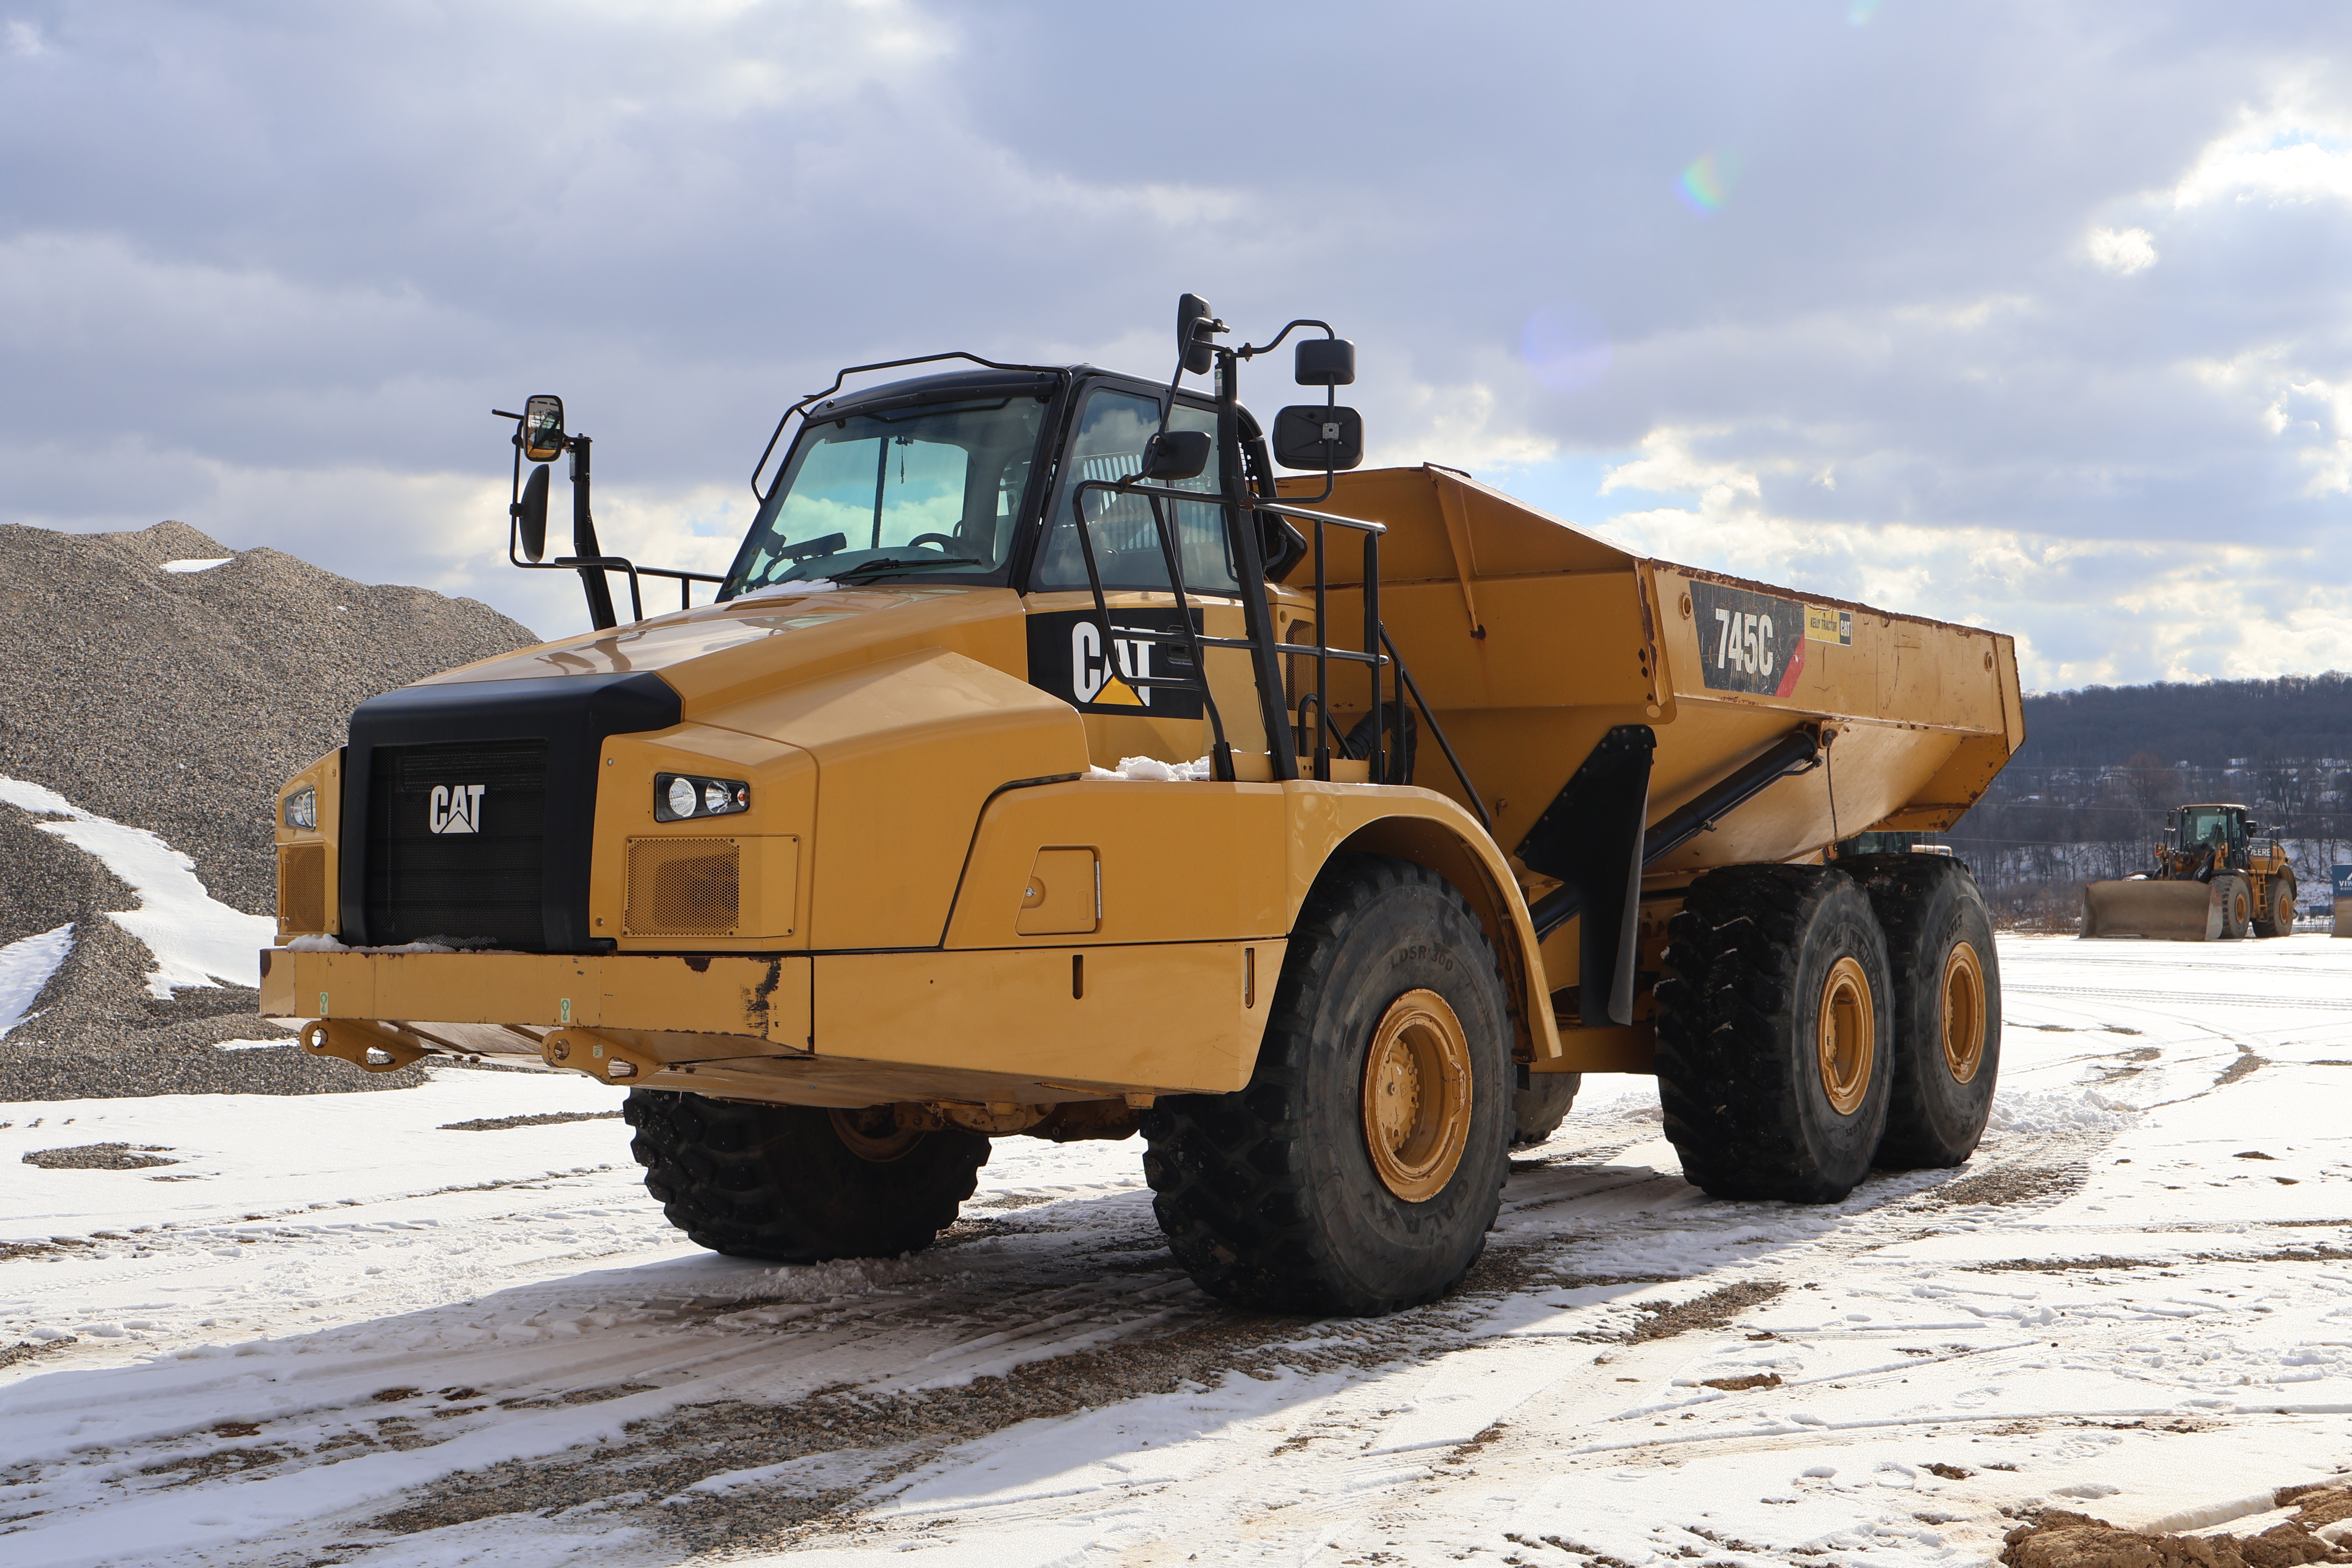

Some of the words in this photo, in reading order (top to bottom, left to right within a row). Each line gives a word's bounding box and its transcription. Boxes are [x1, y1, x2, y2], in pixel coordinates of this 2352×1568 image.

[1810, 617, 1820, 628] KELLY
[1821, 619, 1837, 632] TRACTOR
[1840, 620, 1850, 637] CAT
[1715, 608, 1773, 676] 745C
[1072, 622, 1156, 706] CAT
[430, 784, 485, 833] CAT
[1946, 913, 1962, 946] STL3
[1390, 946, 1426, 969] LDSR
[1432, 949, 1453, 971] 300
